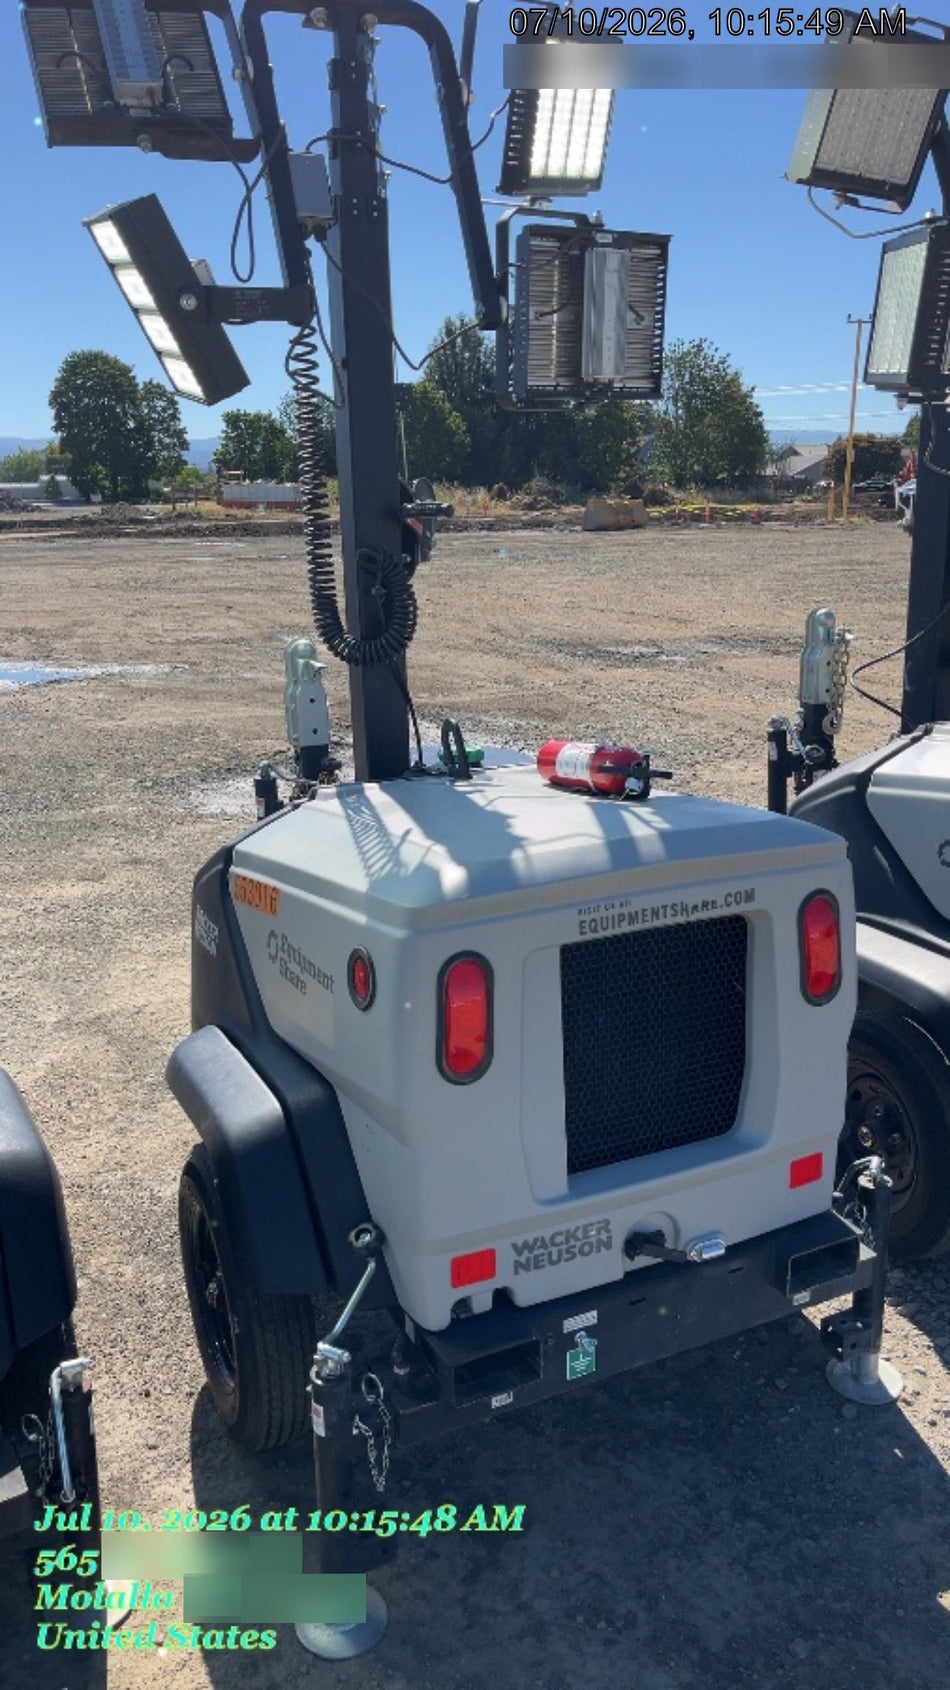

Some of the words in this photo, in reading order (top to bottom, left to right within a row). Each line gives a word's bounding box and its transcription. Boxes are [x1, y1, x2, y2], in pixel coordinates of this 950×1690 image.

[579, 888, 756, 936] EQUIPMENTSHARE.COM
[279, 956, 307, 996] Share
[280, 932, 335, 993] Equipment
[510, 1218, 611, 1257] WACKER
[513, 1235, 613, 1276] NEUSON
